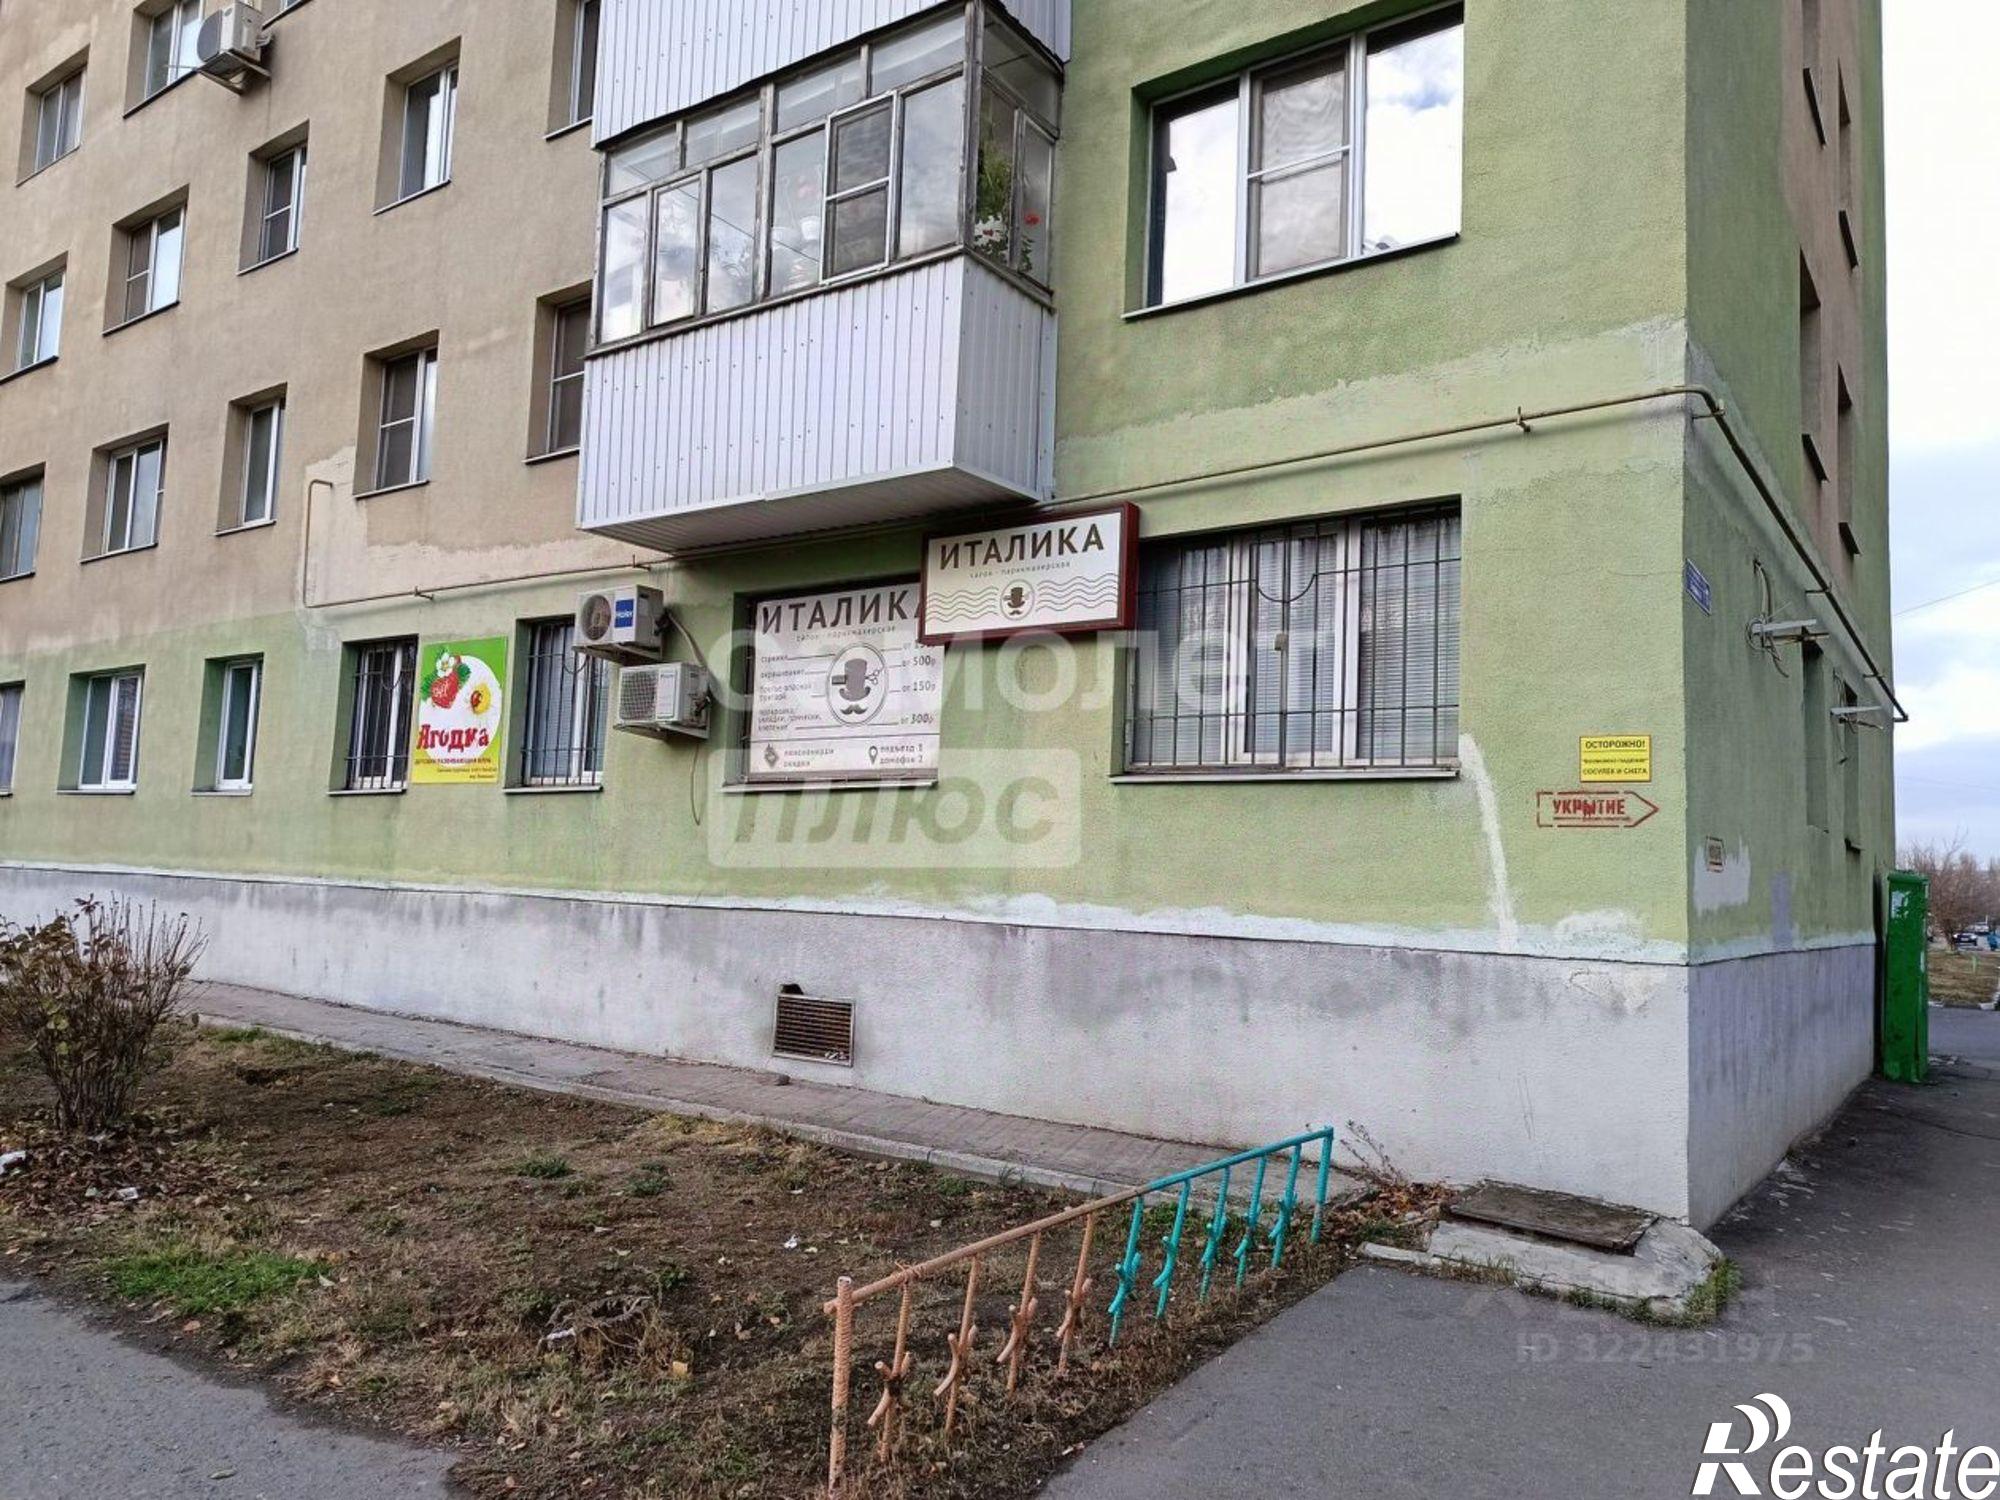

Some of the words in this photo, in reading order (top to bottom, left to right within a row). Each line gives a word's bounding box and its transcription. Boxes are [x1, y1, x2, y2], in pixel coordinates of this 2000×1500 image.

[939, 523, 1105, 570] ИТАЛИКА
[761, 589, 920, 635] ИТАЛИК
[416, 724, 489, 753] Ягодка
[1585, 740, 1646, 749] ОСТОРОЖНО!
[1552, 798, 1626, 816] УКРЫТИЕ
